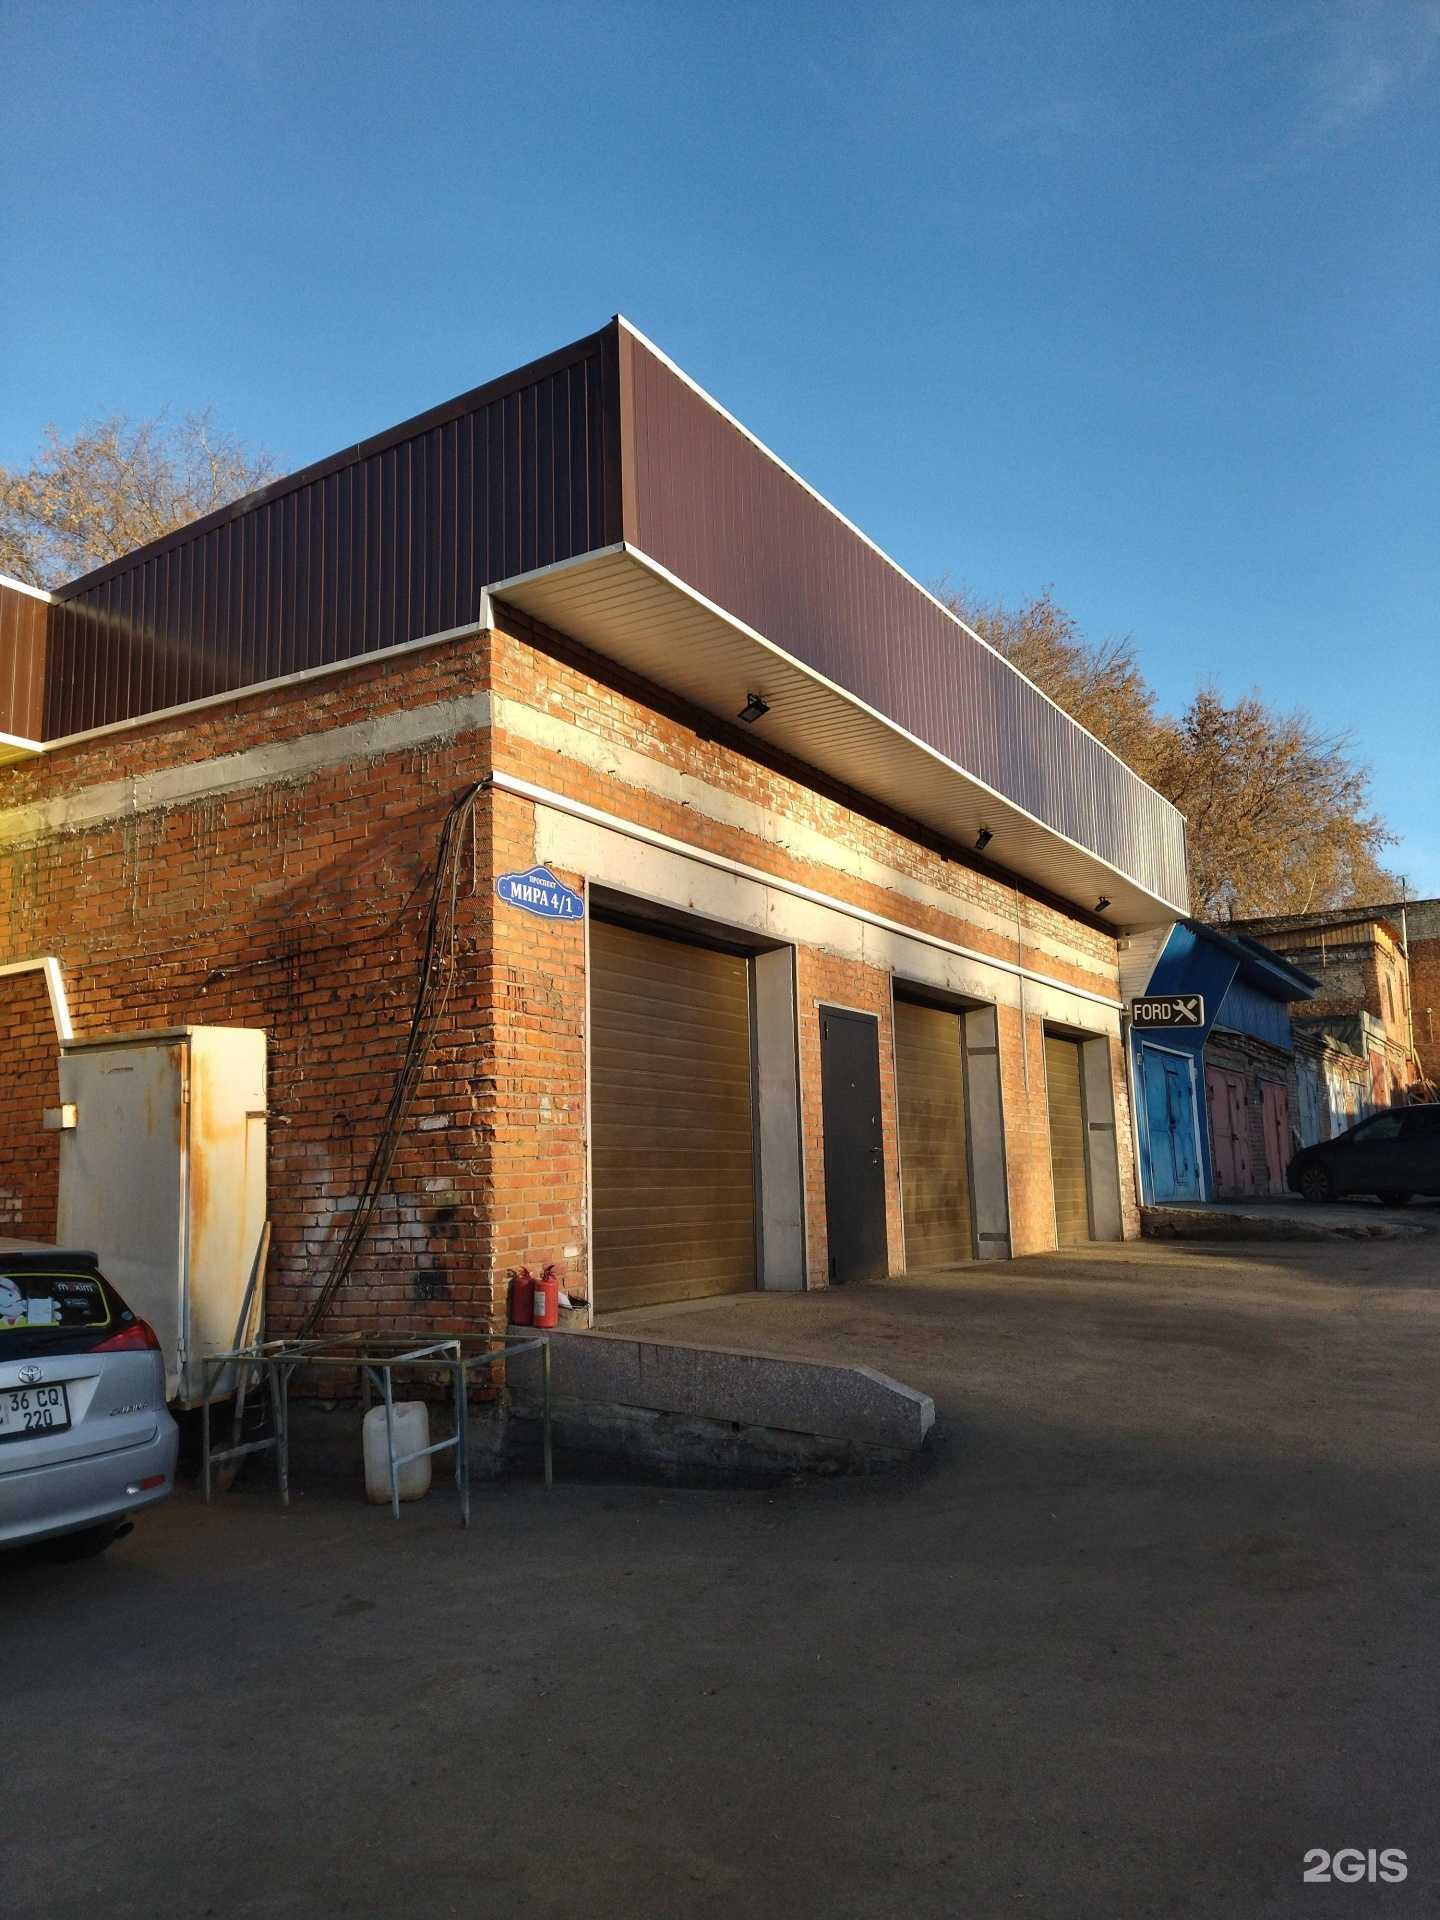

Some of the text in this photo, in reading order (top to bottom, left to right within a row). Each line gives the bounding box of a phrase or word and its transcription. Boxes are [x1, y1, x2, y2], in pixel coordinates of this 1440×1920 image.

[529, 875, 557, 889] ПРОСПЕКТ
[510, 881, 573, 914] МИРА 4/1
[1134, 1003, 1172, 1021] FORD
[9, 1392, 30, 1412] 36
[23, 1408, 54, 1431] 220
